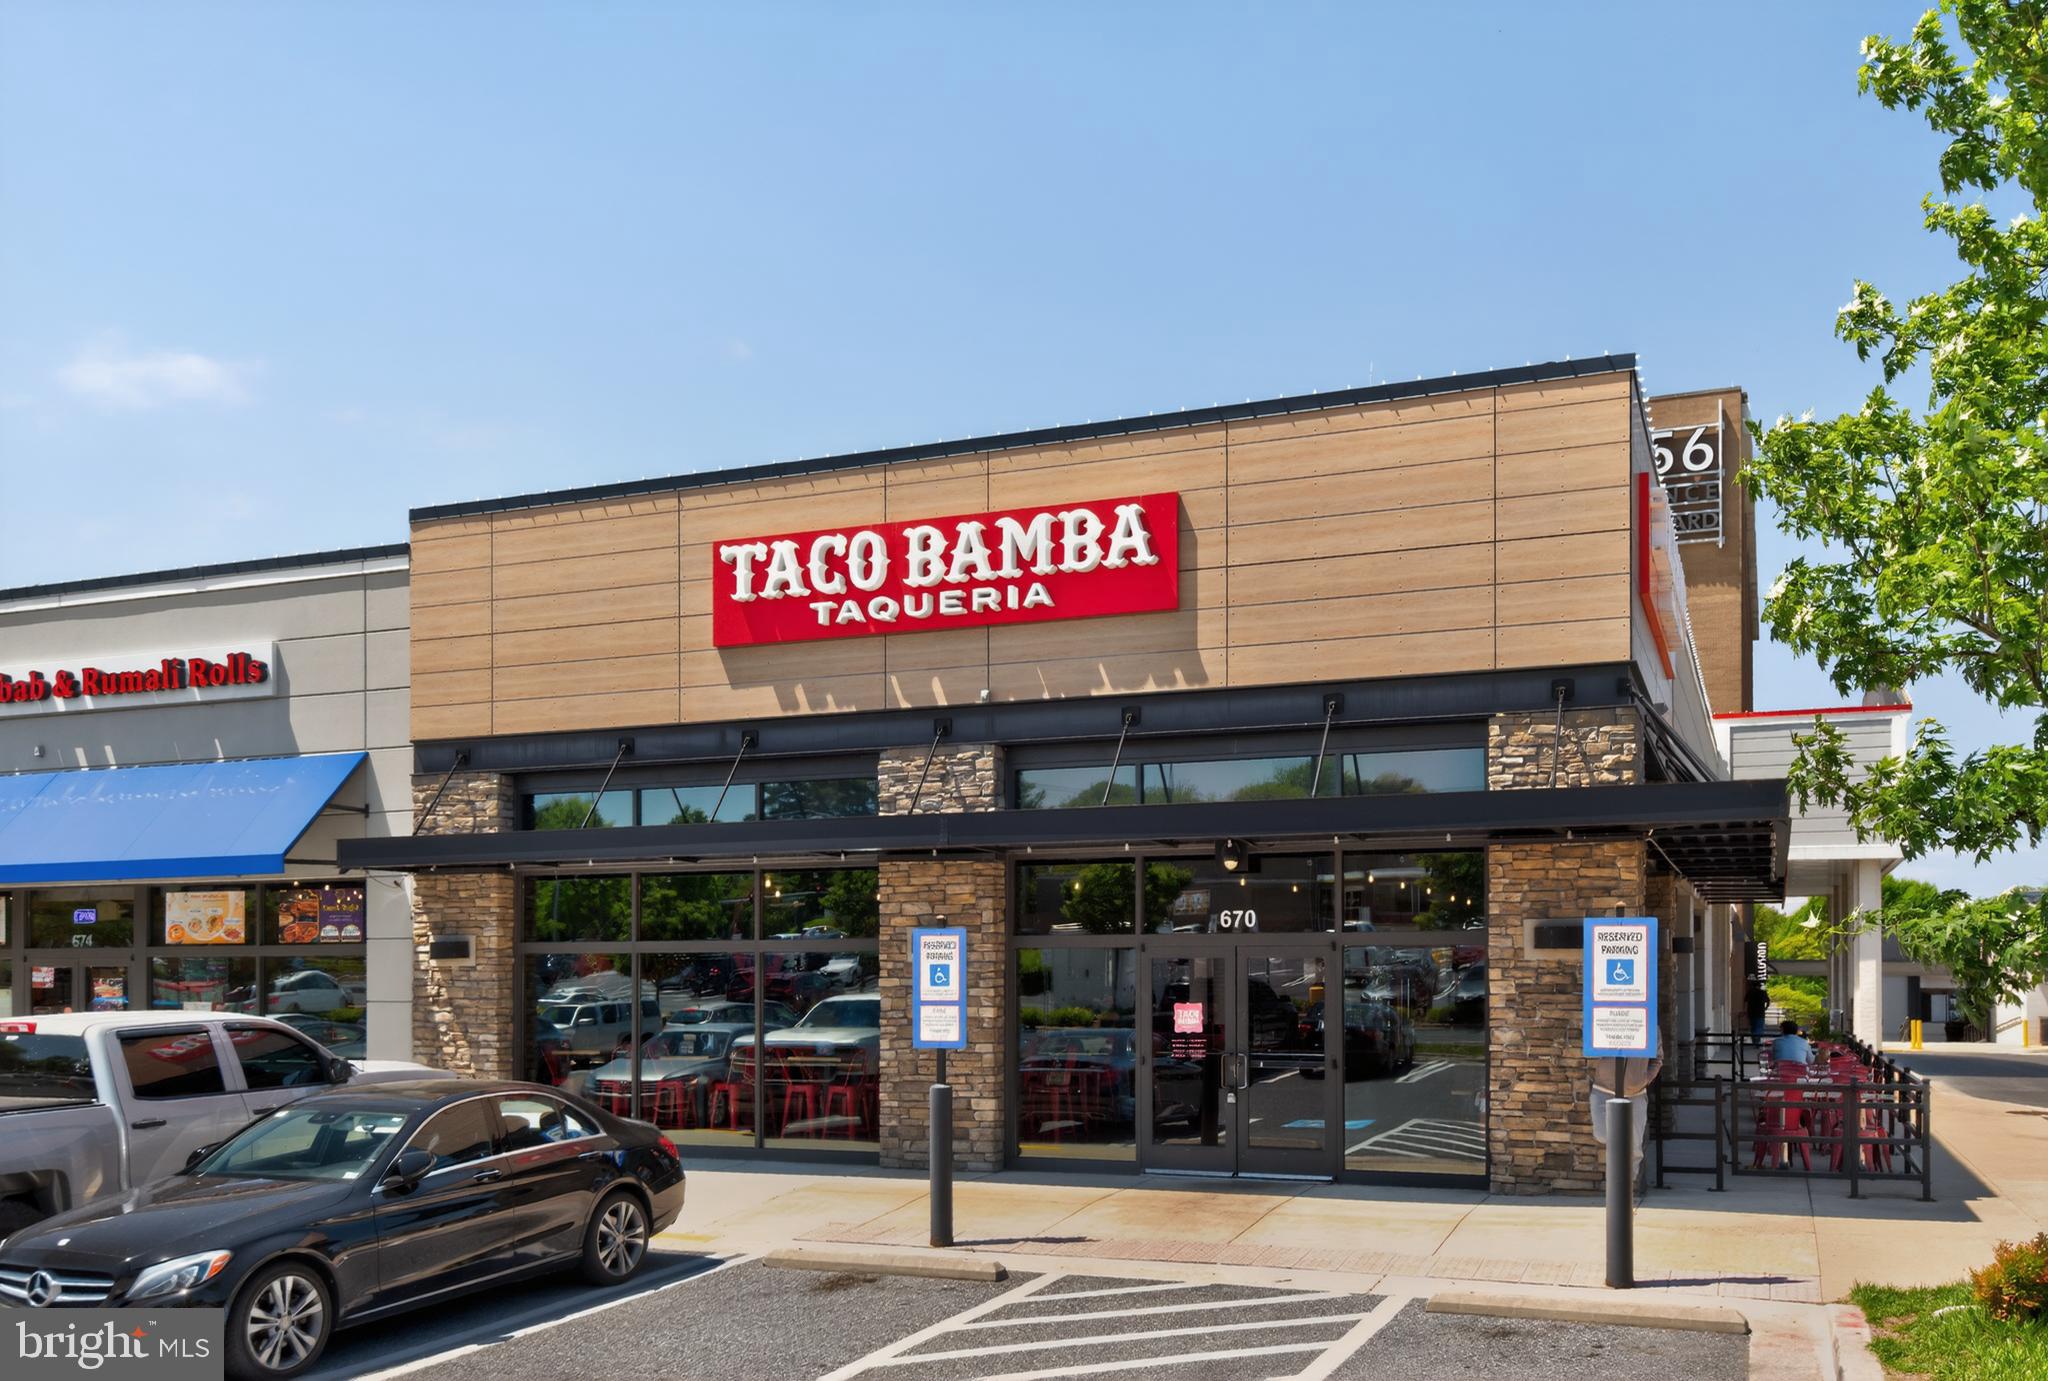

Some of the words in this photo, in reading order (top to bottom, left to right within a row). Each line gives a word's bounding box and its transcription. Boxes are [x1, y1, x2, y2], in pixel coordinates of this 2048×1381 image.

[720, 530, 891, 602] TACO
[902, 503, 1159, 588] BAMBA
[809, 583, 1055, 626] TAQUERIA
[53, 669, 80, 699] &
[82, 657, 185, 696] Rumali
[188, 652, 267, 688] Rolls
[72, 934, 93, 947] 674
[1220, 910, 1257, 928] 670
